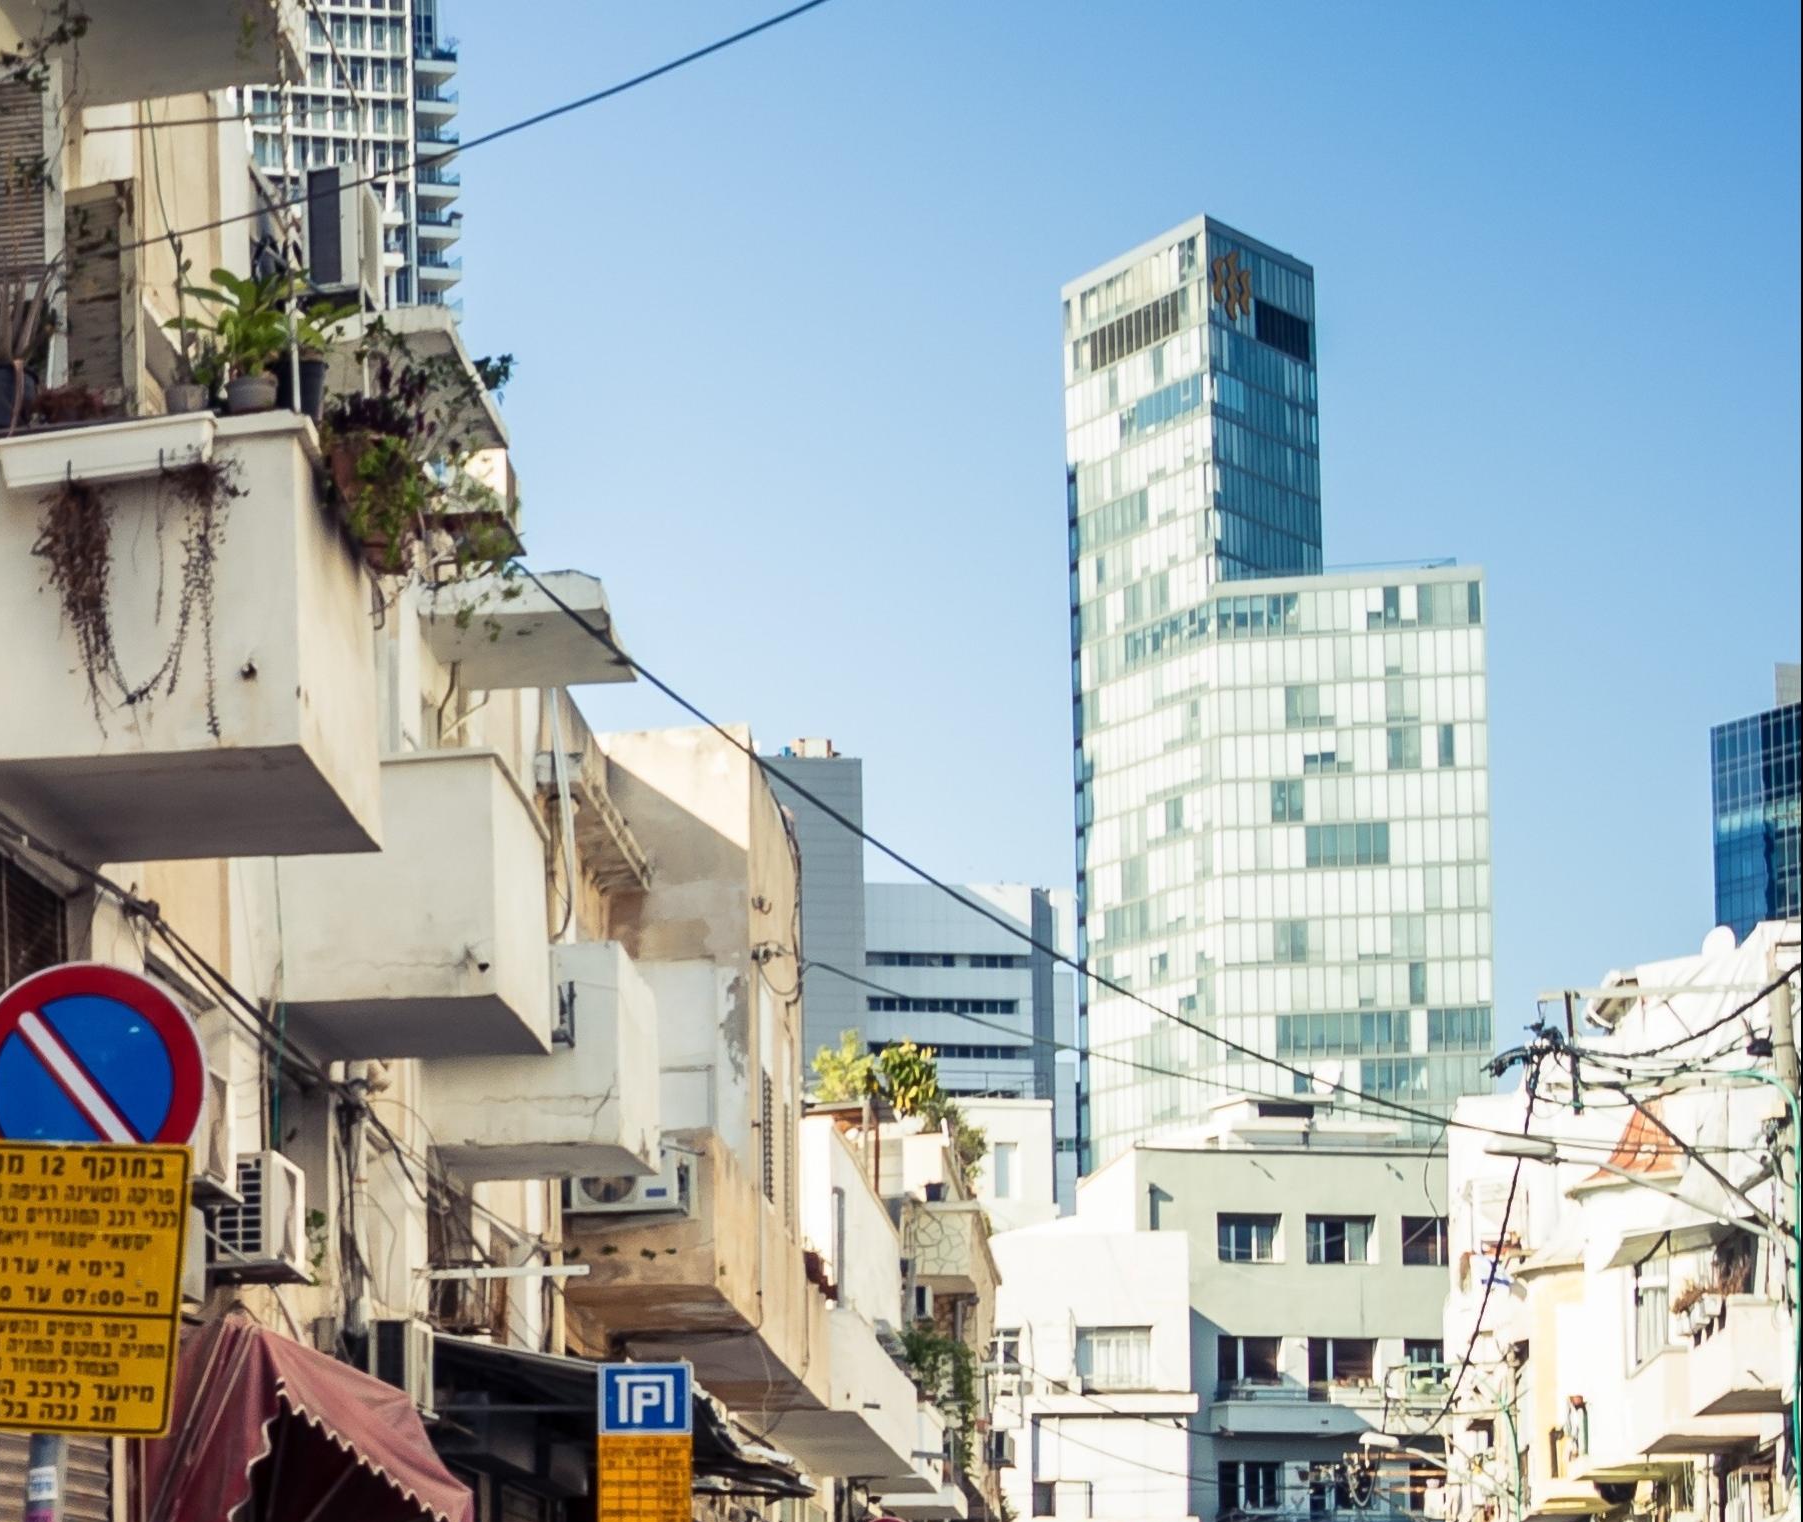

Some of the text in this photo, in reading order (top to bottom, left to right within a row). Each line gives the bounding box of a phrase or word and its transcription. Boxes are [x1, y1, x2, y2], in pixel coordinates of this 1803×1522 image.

[41, 1155, 65, 1176] 12
[82, 1156, 165, 1181] בתוקף
[25, 1286, 51, 1303] עד
[27, 1380, 81, 1399] לרכב
[93, 1382, 154, 1403] מיועד
[39, 1402, 78, 1420] נכה
